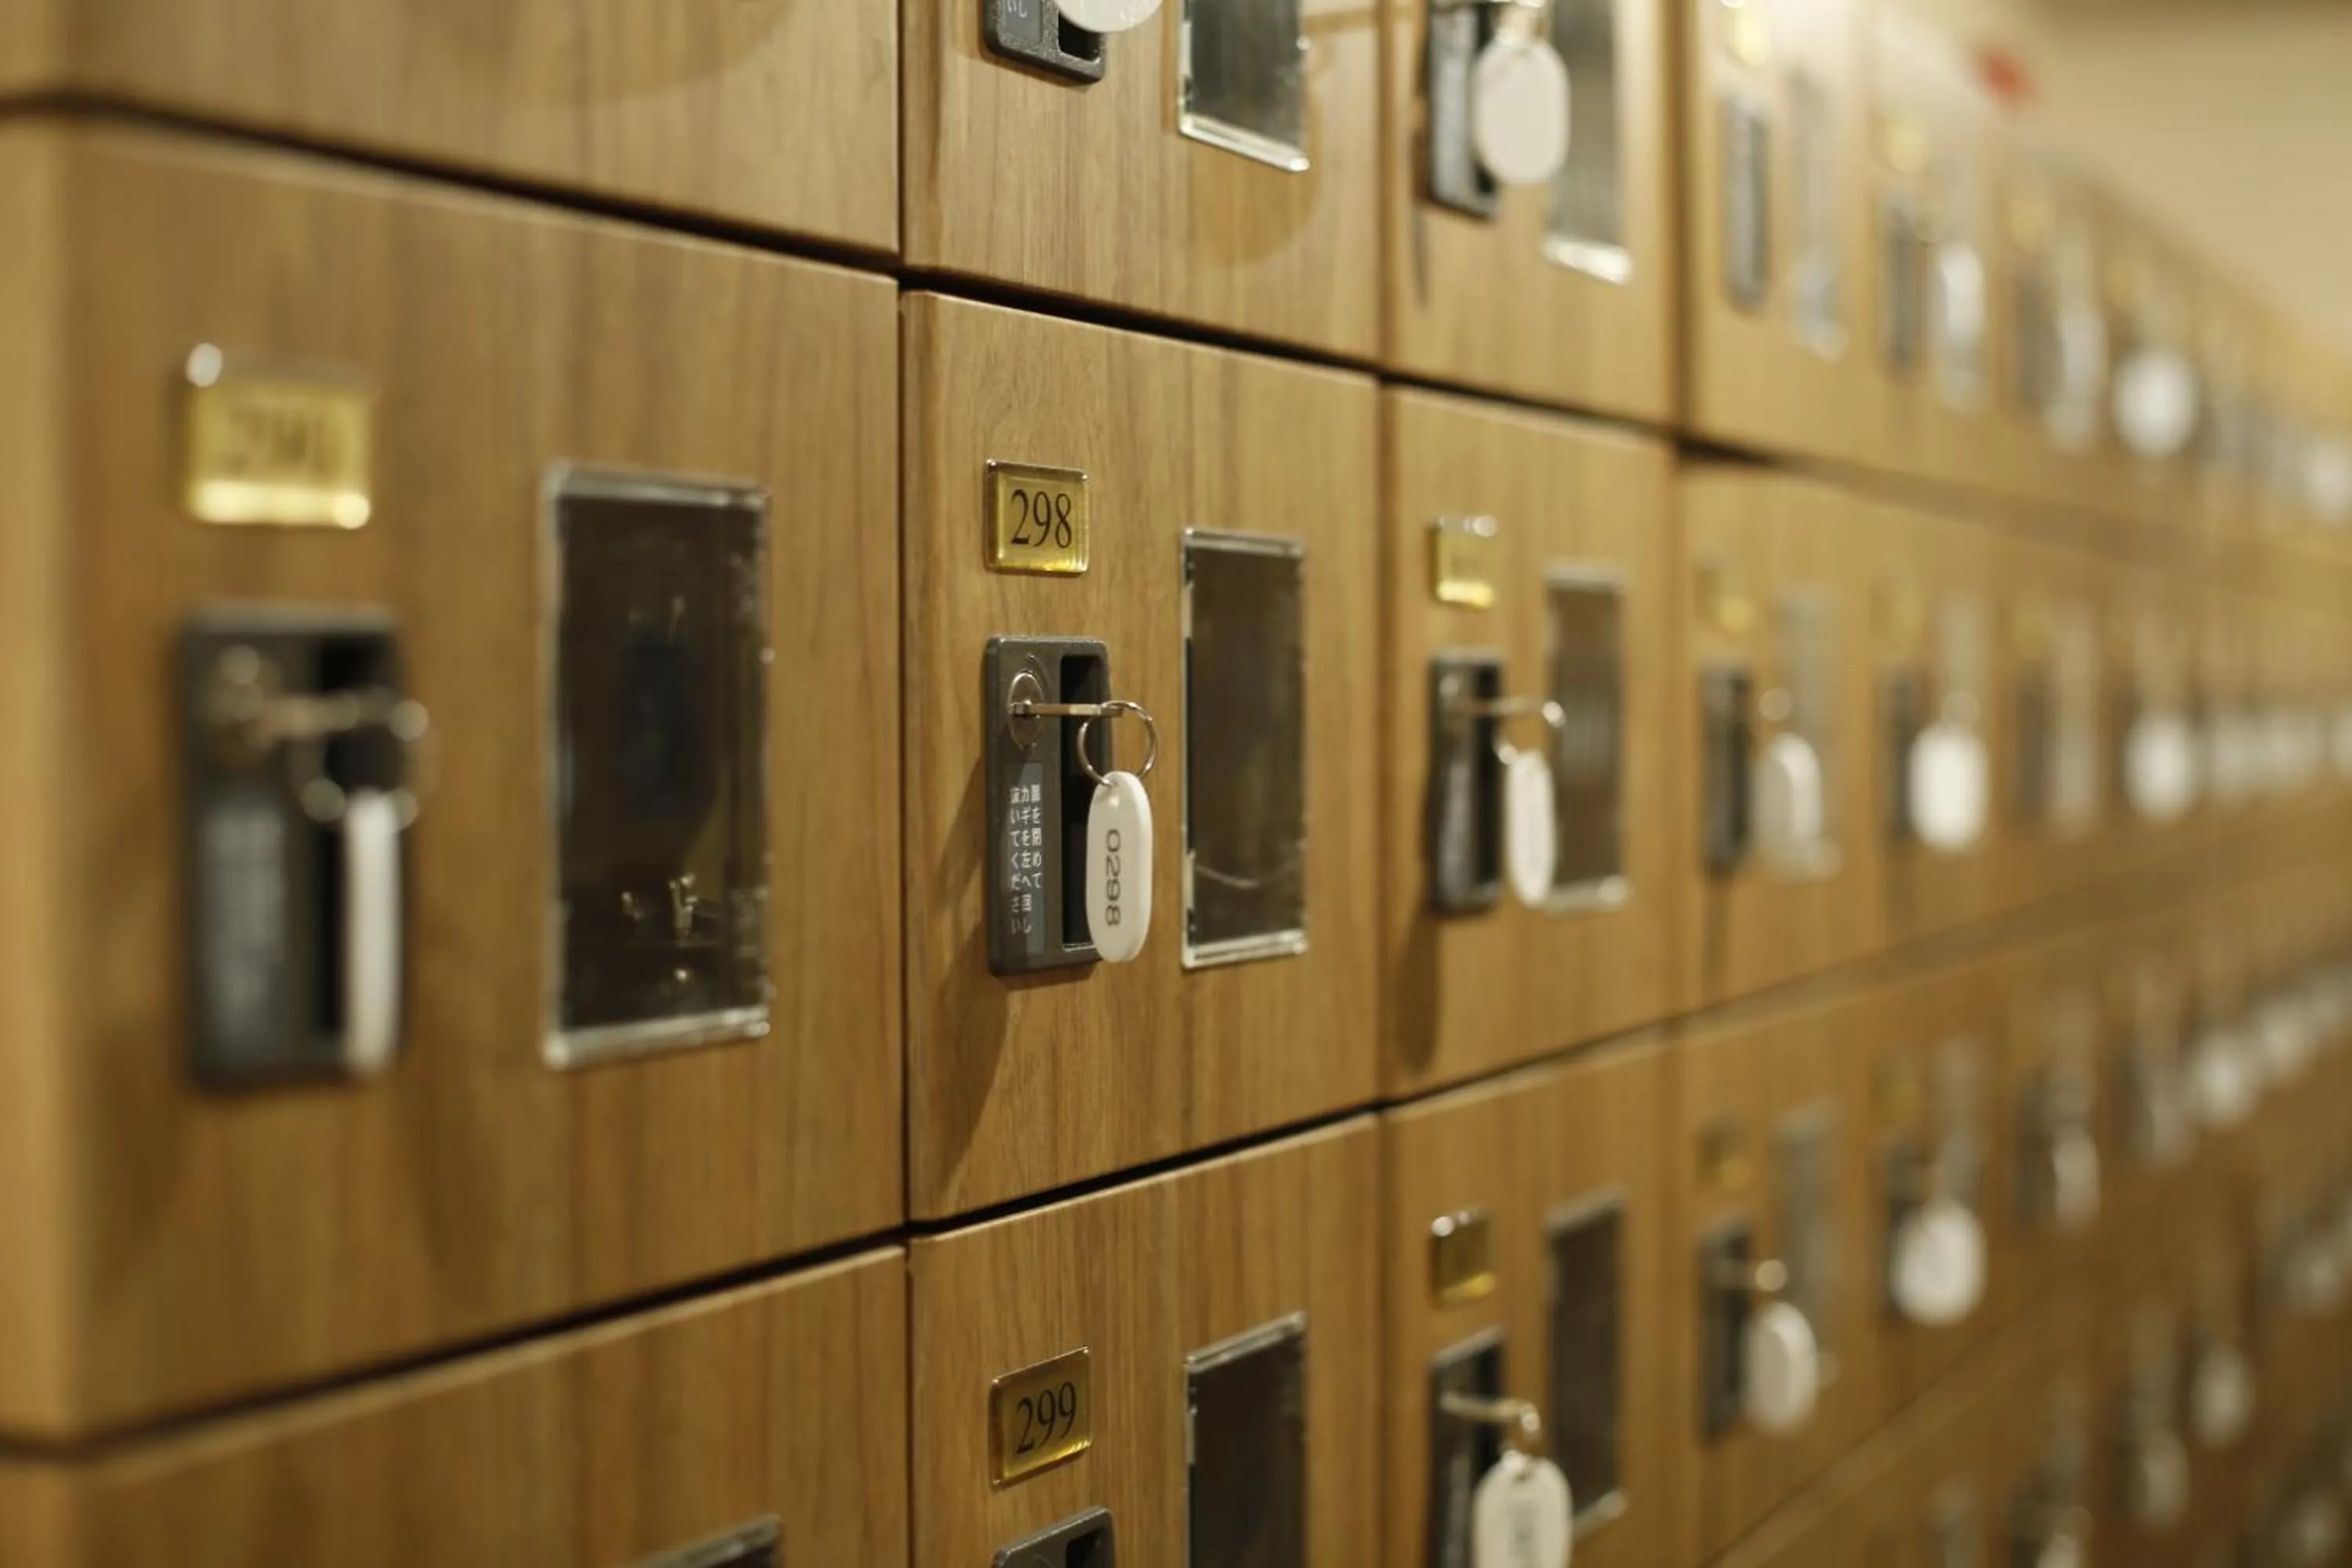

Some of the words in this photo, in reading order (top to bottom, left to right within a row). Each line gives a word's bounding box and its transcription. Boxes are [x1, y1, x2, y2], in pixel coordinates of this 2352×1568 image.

[1011, 488, 1073, 549] 298
[1105, 829, 1122, 927] 0298
[1015, 1381, 1076, 1454] 299
